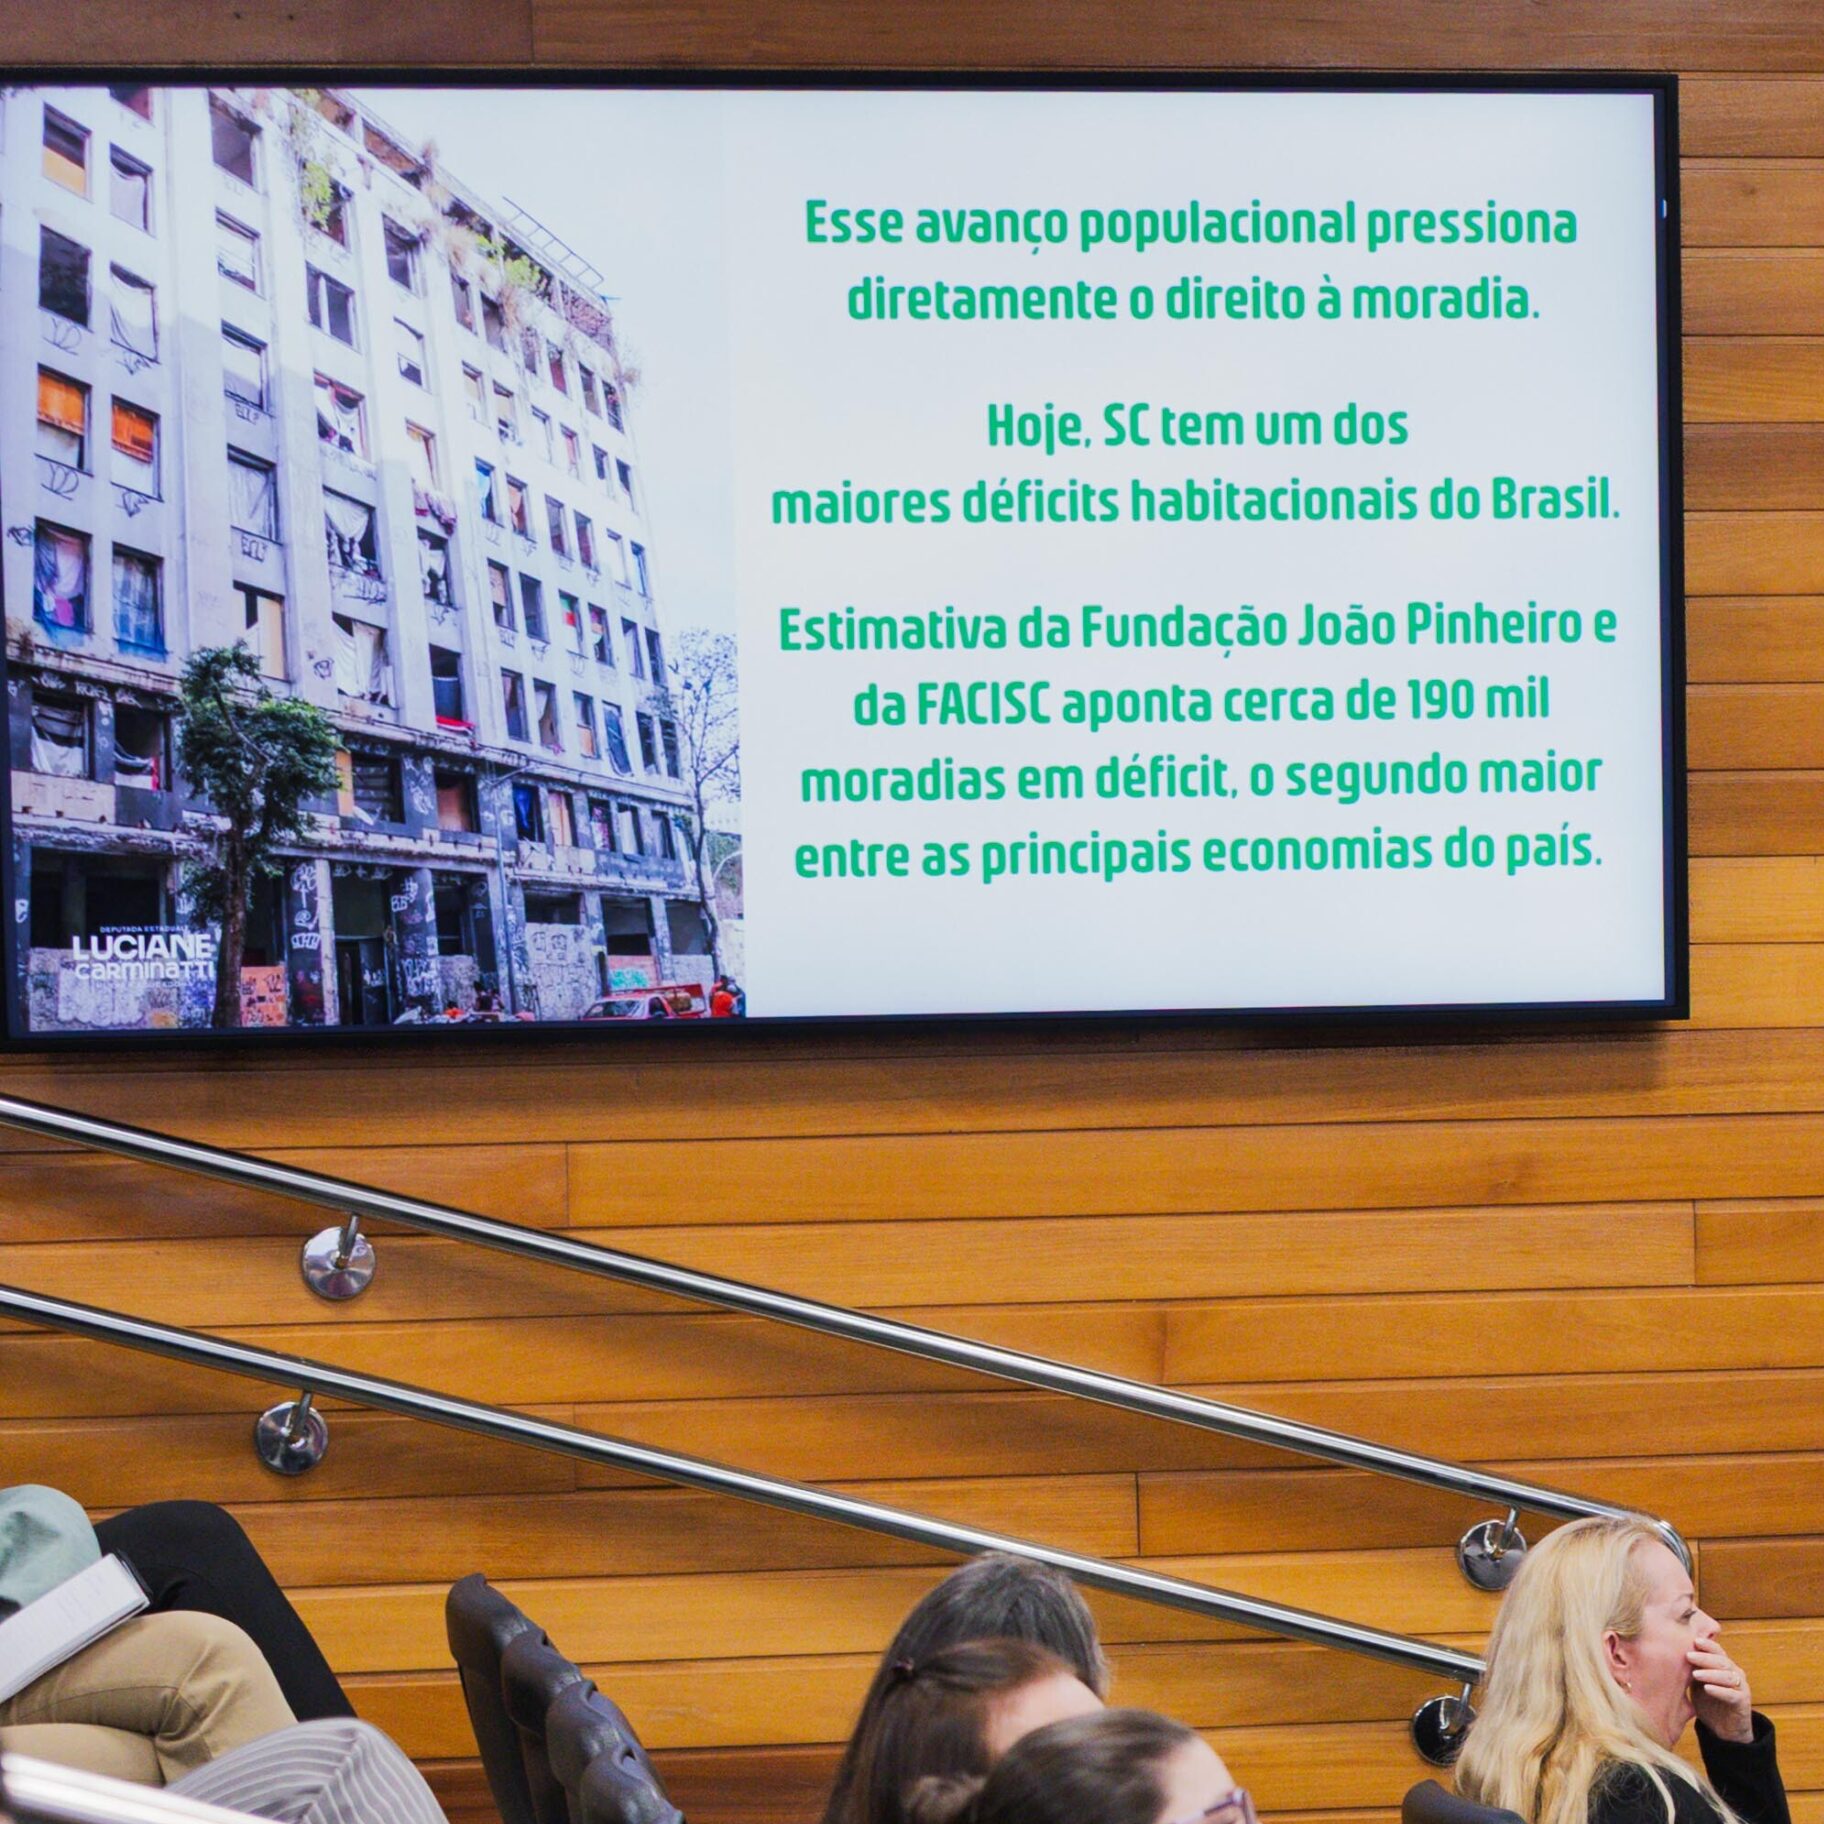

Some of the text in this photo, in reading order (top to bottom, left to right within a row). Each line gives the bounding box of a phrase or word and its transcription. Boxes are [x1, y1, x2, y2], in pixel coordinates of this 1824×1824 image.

[806, 199, 1578, 255] Esse avanço populacional pressiona
[848, 274, 1540, 320] diretamente o direito à moradia.
[988, 402, 1408, 456] Hoje, SC tem um dos
[772, 476, 1620, 524] maiores déficits habitacionais do Brasil.
[780, 601, 1617, 657] Estimativa da Fundação João Pinheiro e
[853, 675, 1550, 733] da FACISC aponta cerca de 190 mil
[801, 749, 1604, 805] moradias em déficit, o segundo maior
[795, 822, 1601, 884] entre as principais economias do país.
[72, 934, 212, 960] LUCIANE
